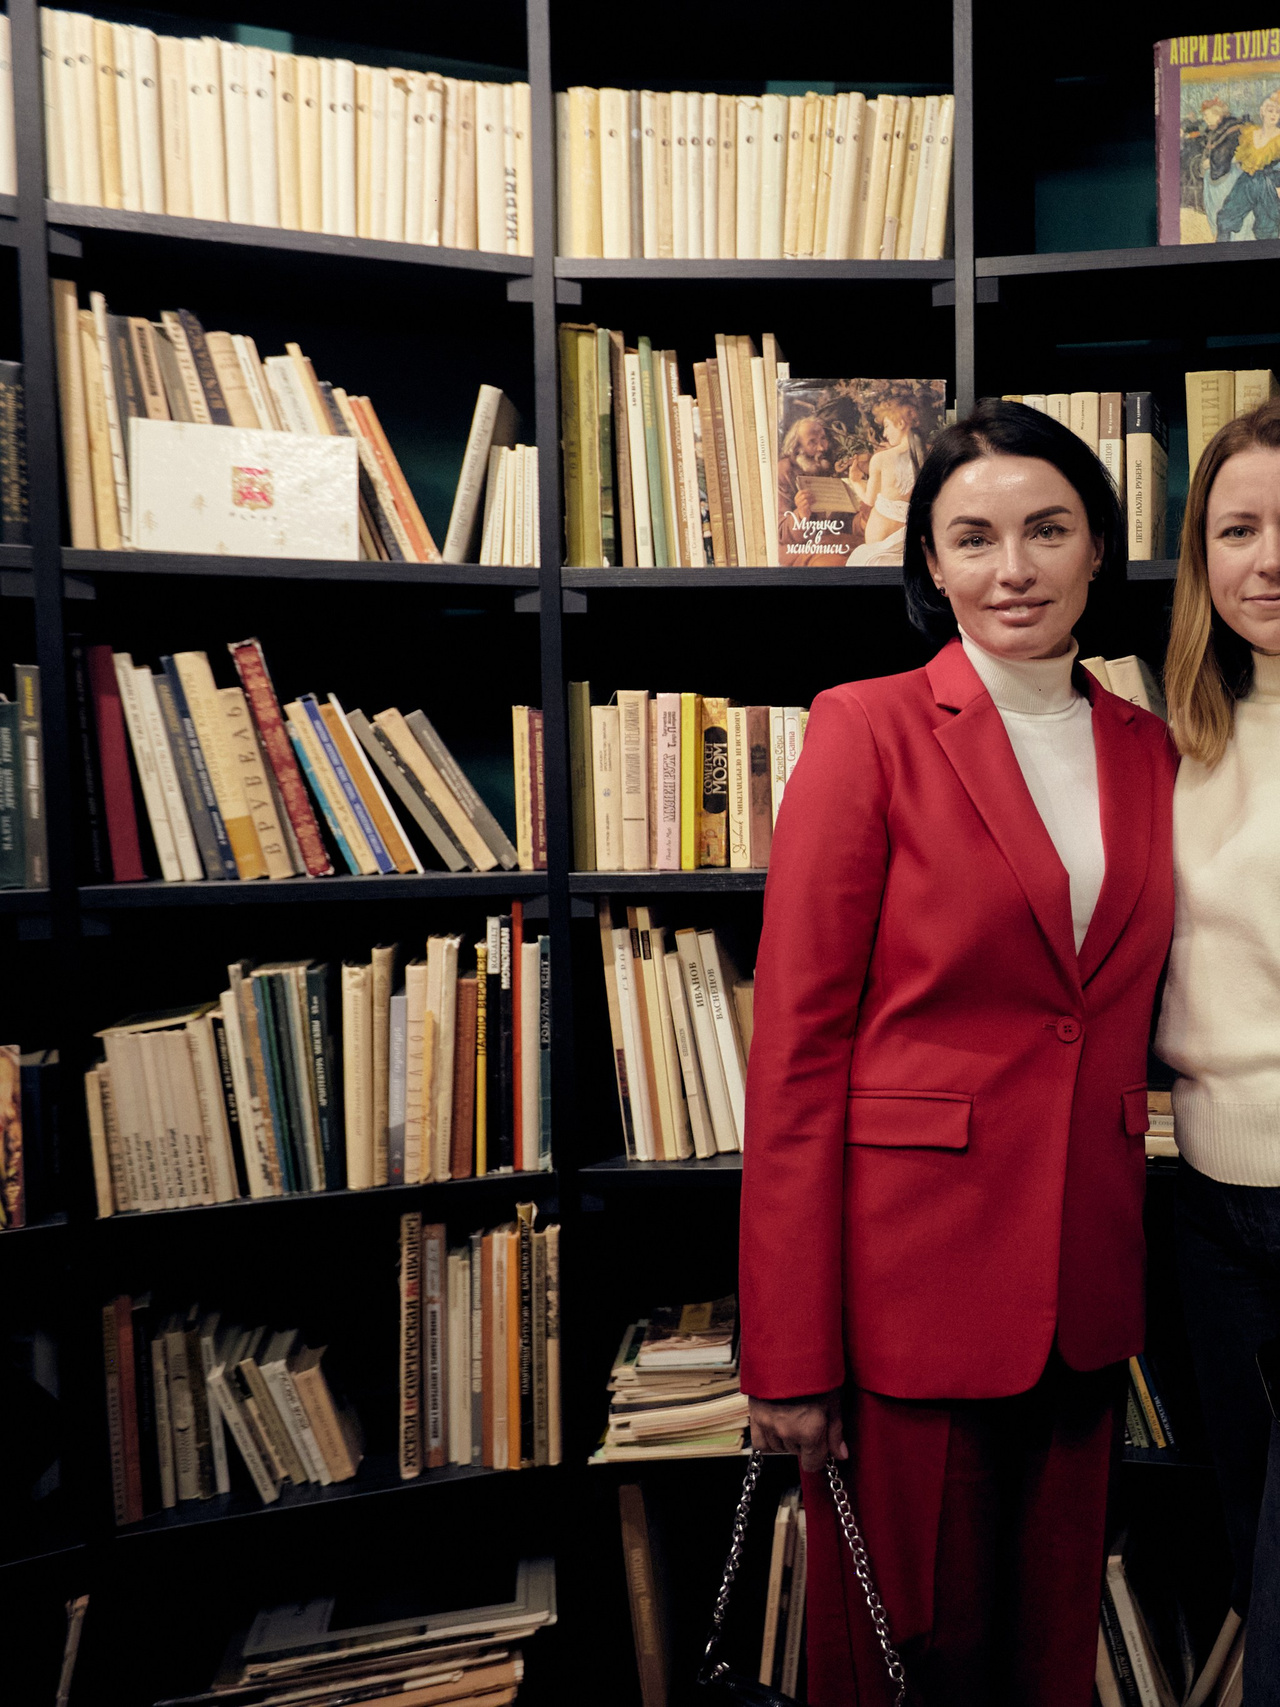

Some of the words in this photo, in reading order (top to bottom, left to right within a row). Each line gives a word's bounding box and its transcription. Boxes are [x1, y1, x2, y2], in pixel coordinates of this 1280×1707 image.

[1170, 35, 1208, 65] АНРИ
[1212, 32, 1231, 63] ДЕ
[784, 511, 844, 538] Музыка
[815, 530, 823, 544] в
[786, 539, 850, 554] живописи
[773, 734, 784, 754] Сёра
[785, 730, 797, 761] Сезанна
[224, 705, 280, 855] ВРУБЕЛЬ
[662, 752, 675, 780] РУЖ
[704, 743, 714, 796] СОМЕРСЕТ
[712, 742, 728, 796] МОЭМ
[775, 755, 785, 782] Жизнь
[662, 781, 676, 822] МУЛЕН
[490, 926, 498, 968] ROUAULT
[500, 927, 510, 989] MONDRIAN
[477, 956, 485, 1008] ВЕРОНЕЗЕ
[540, 959, 549, 988] КЕНТ
[687, 961, 704, 1007] ИВАНОВ
[705, 967, 723, 1020] ВАСНЕЦОВ
[477, 1015, 487, 1055] ПАОЛО
[540, 993, 549, 1042] РОКУЭЛЛ
[403, 1299, 418, 1410] ИСТОРИЧЕСКАЯ
[1153, 1394, 1170, 1430] ИСКУССТВА
[404, 1414, 416, 1471] УССКАЯ
